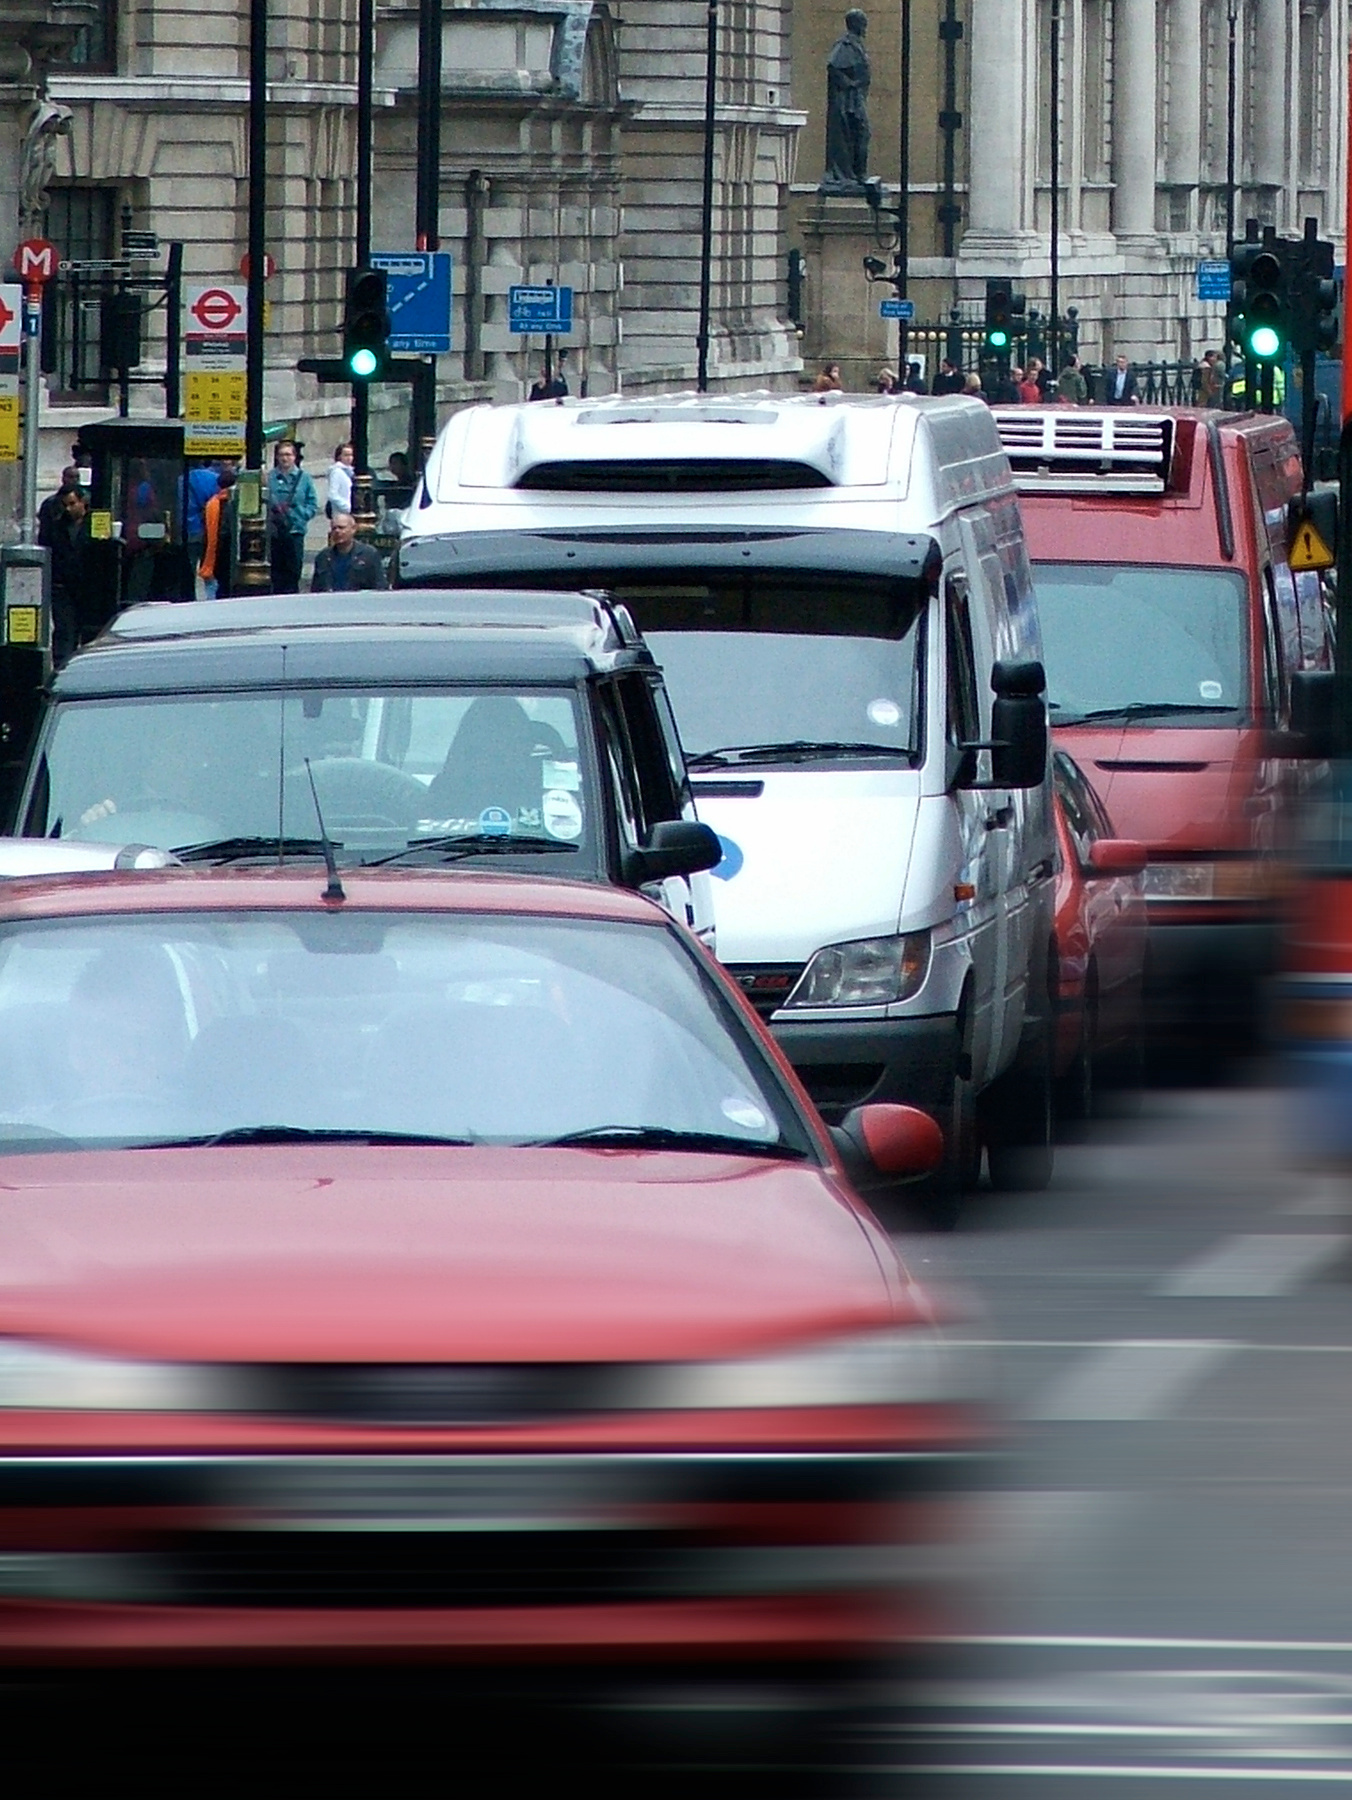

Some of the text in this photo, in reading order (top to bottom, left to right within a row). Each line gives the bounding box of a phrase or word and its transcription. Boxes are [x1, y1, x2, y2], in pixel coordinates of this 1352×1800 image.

[22, 246, 51, 275] M
[28, 318, 37, 333] 1
[392, 339, 437, 349] any time
